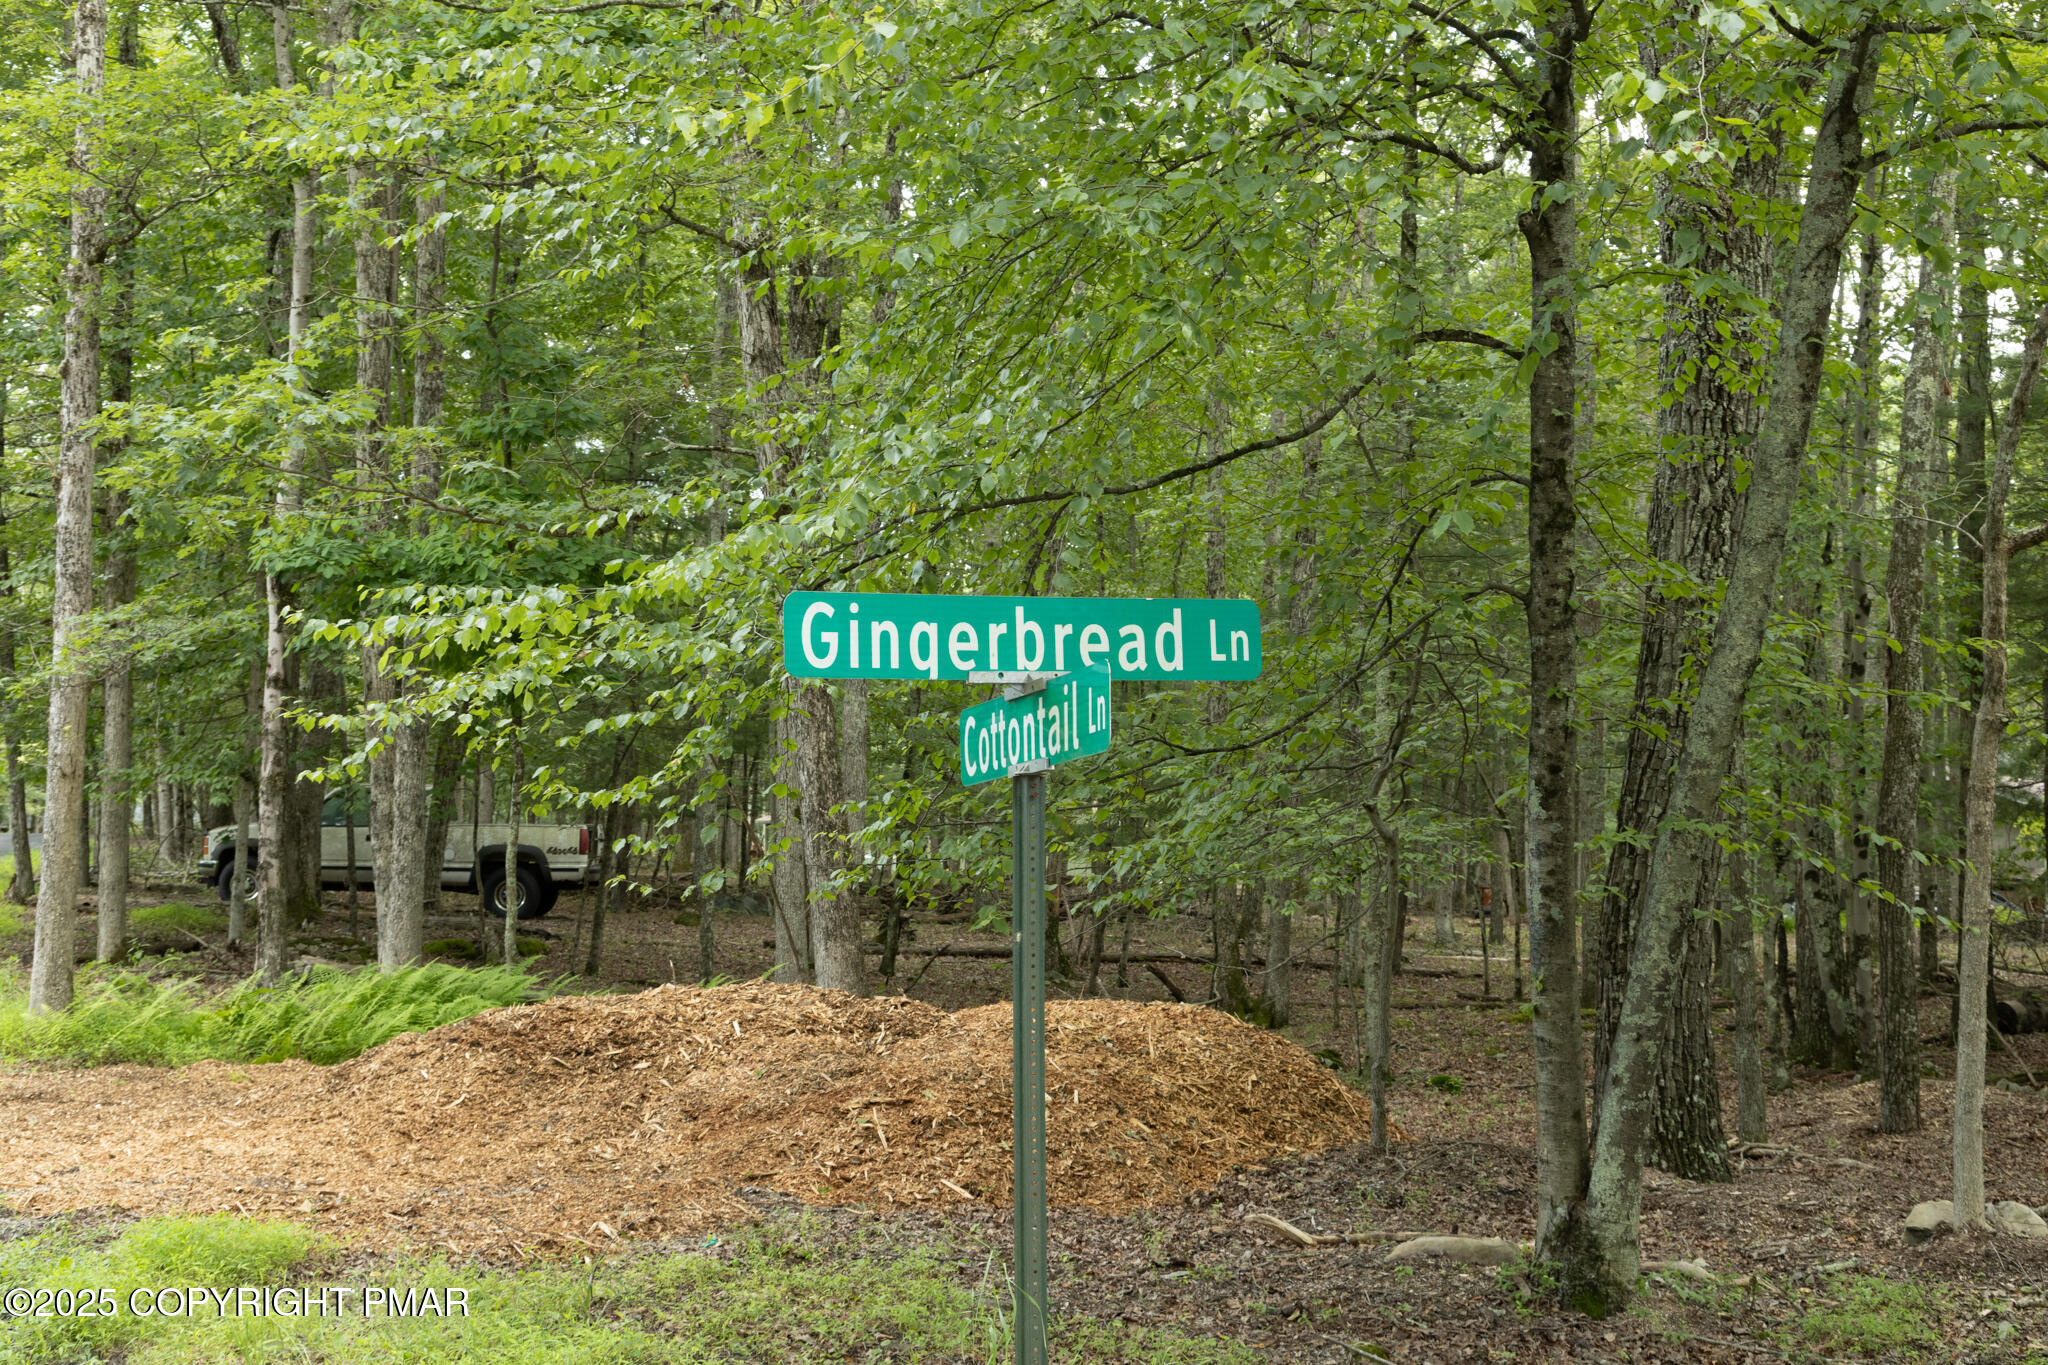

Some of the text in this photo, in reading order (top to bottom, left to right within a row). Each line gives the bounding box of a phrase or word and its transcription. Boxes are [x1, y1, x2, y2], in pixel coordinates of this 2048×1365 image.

[801, 601, 1250, 680] Gingerbread Ln
[964, 680, 1106, 777] Cottontail Ln
